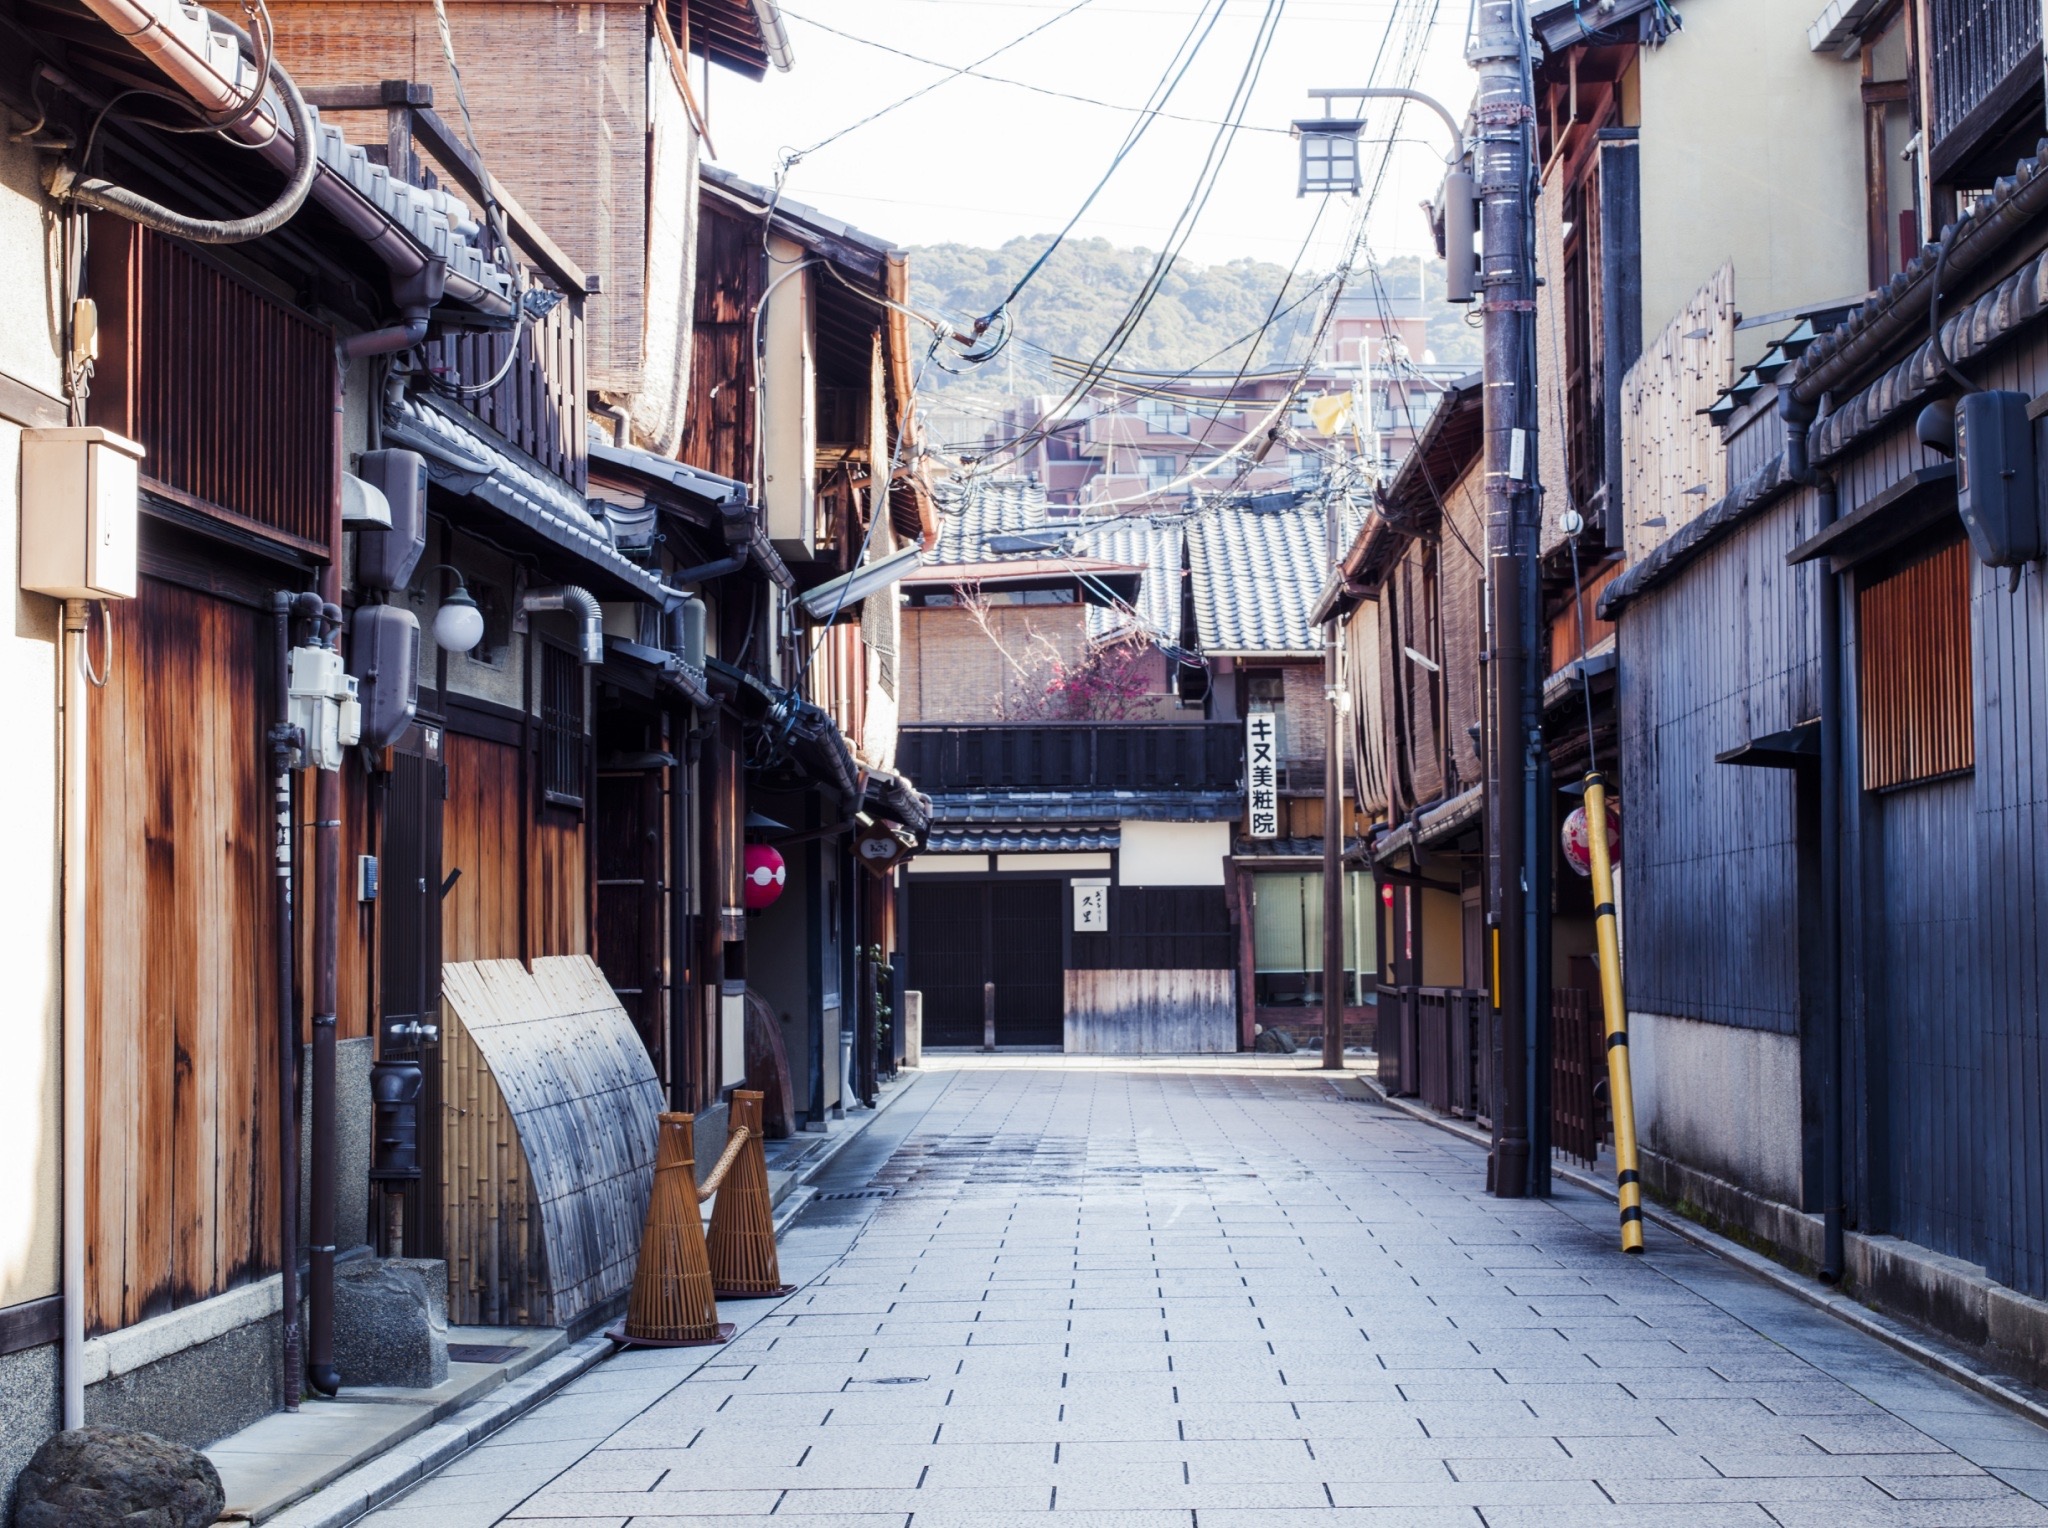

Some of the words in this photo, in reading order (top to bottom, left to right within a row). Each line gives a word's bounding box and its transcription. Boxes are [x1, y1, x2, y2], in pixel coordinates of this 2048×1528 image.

[1251, 718, 1275, 834] キヌ美粧院
